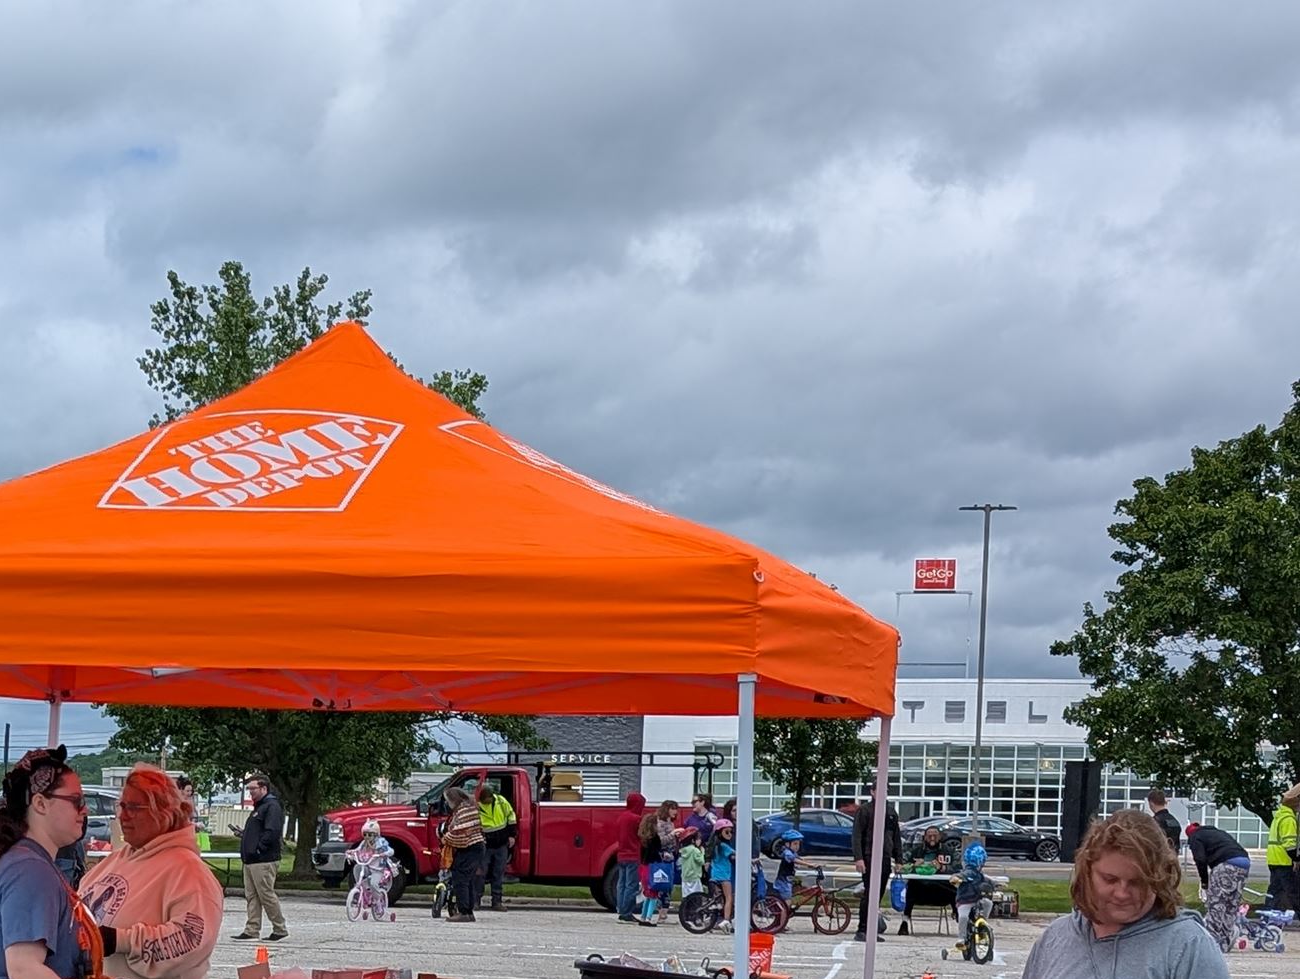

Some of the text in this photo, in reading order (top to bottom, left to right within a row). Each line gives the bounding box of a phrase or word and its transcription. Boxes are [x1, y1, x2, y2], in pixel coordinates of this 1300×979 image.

[168, 421, 276, 459] THE
[118, 417, 390, 507] HOME
[199, 452, 370, 508] DEPOT
[917, 569, 954, 578] GetGo
[902, 701, 1084, 724] TESL
[551, 754, 612, 764] SERVICE
